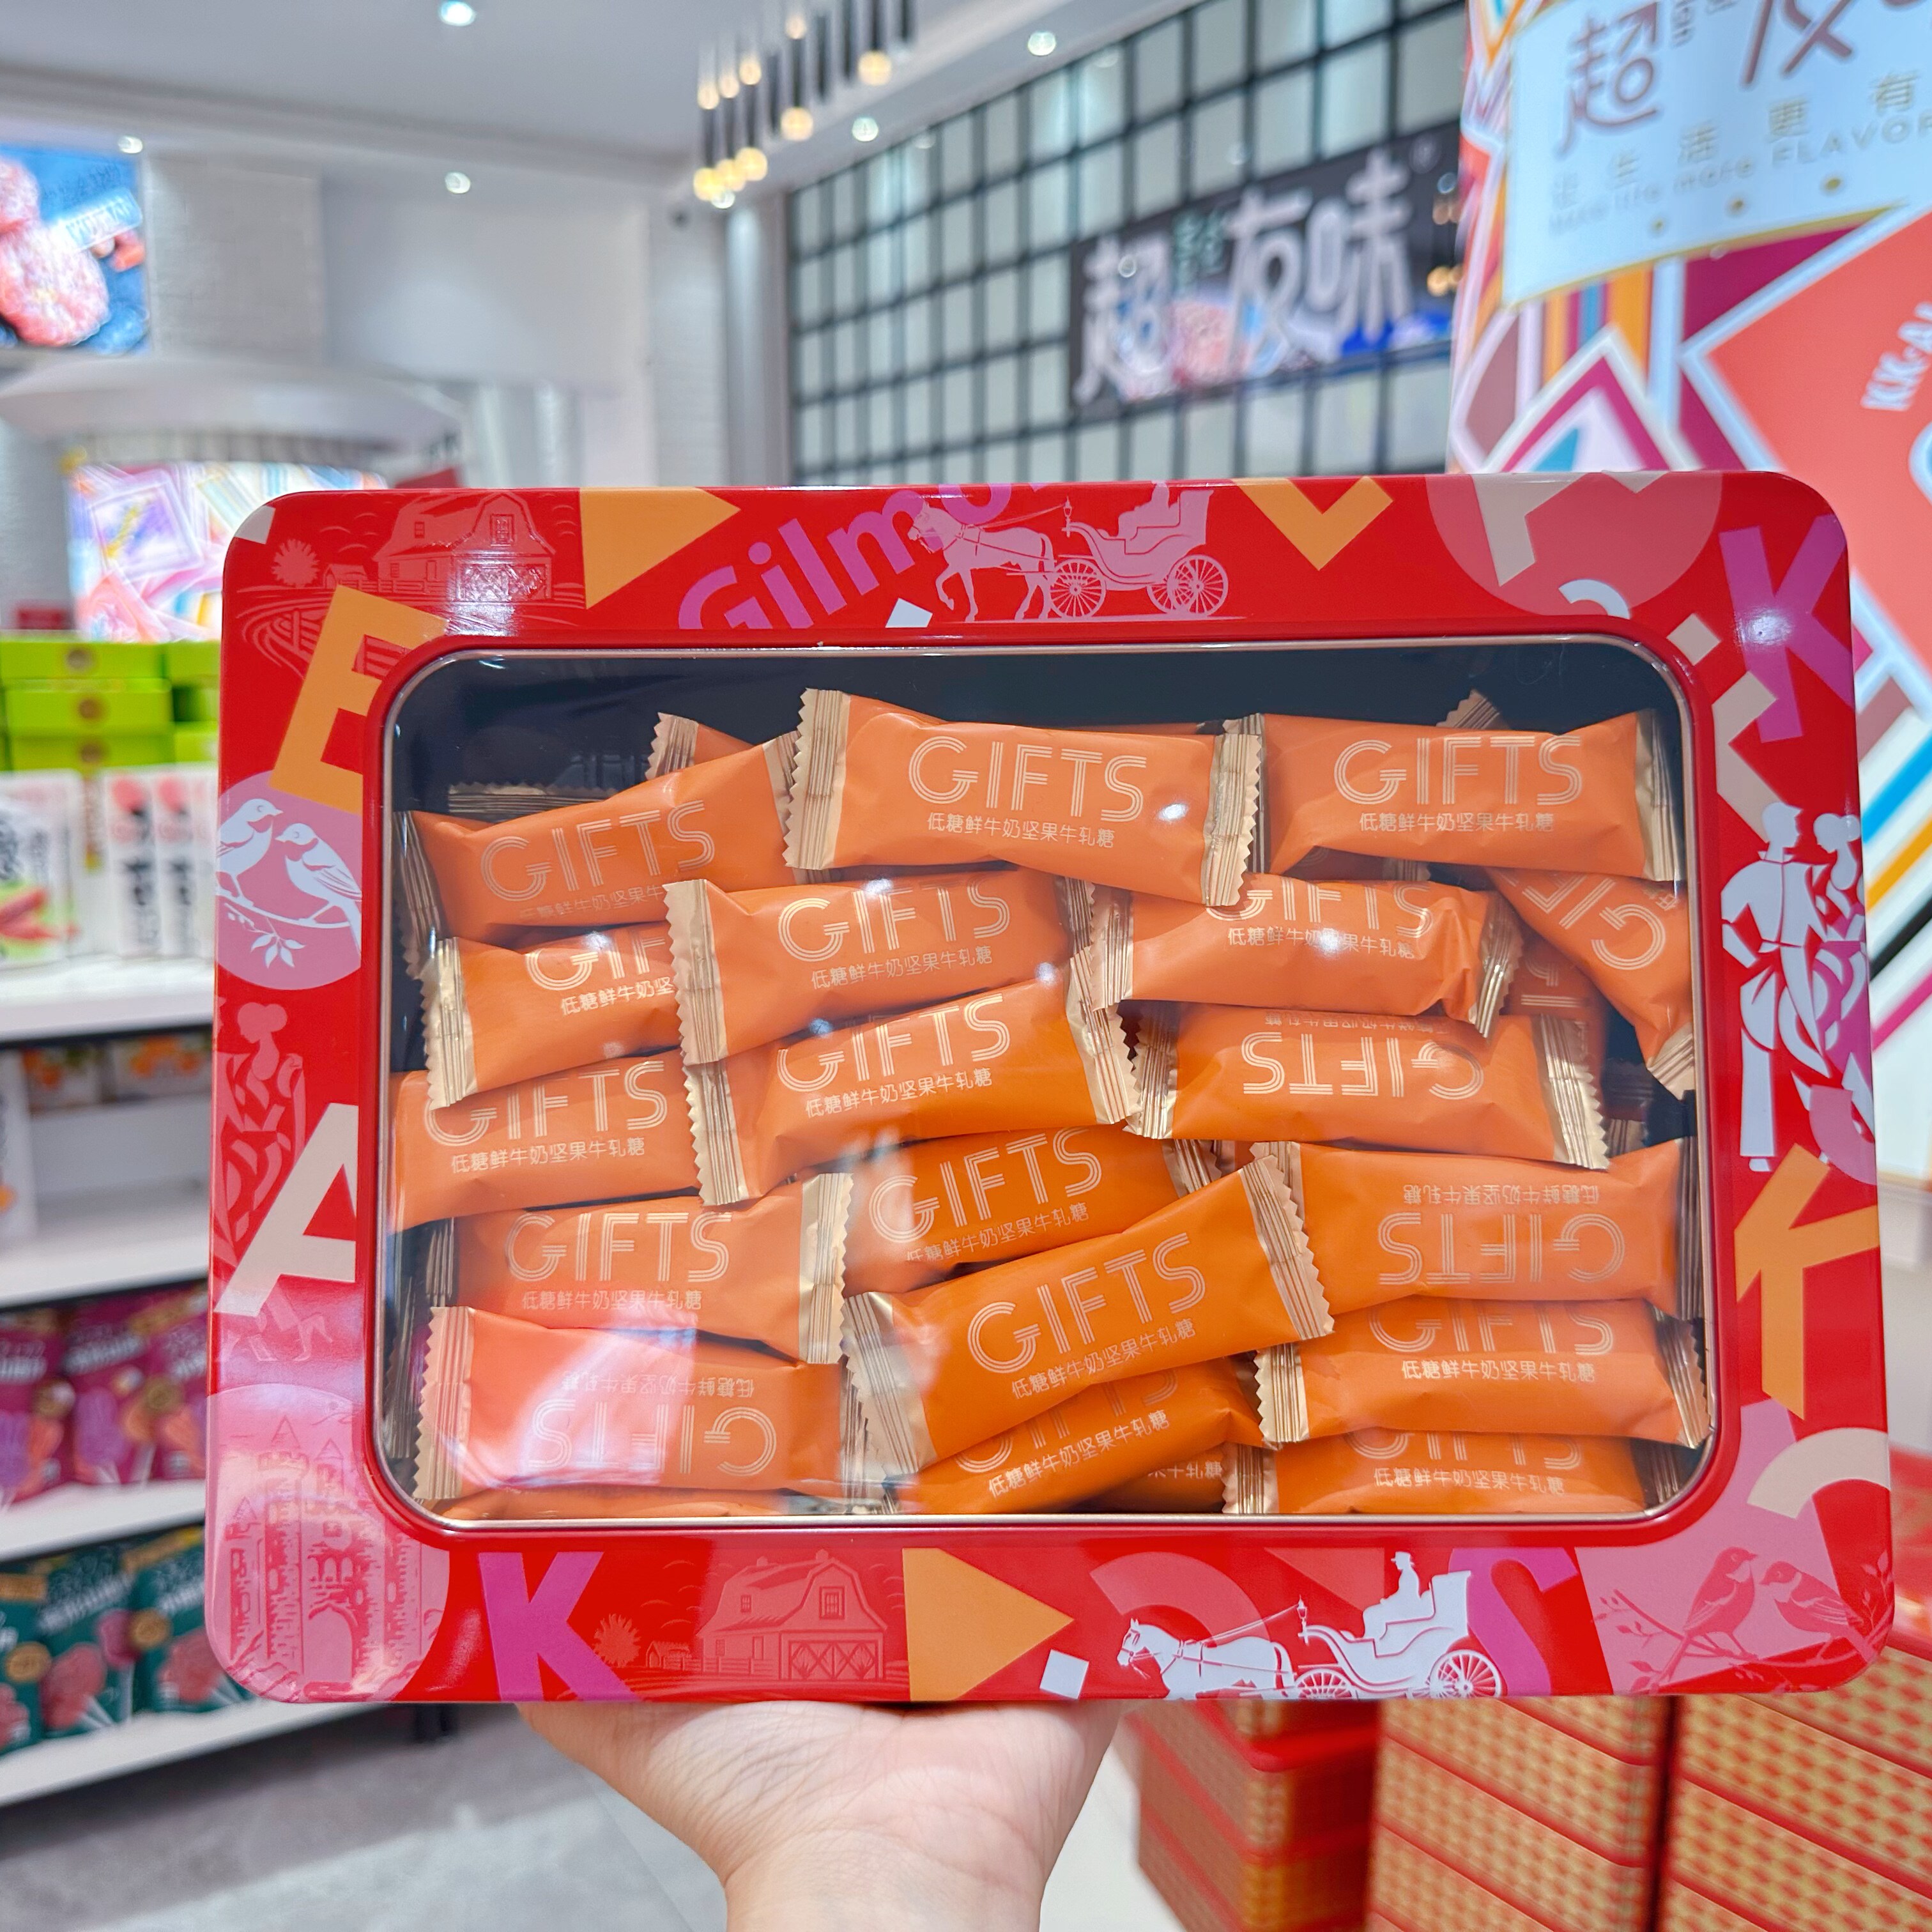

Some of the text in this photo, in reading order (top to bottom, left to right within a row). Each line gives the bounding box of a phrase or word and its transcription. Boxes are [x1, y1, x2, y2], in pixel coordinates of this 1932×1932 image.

[908, 735, 1147, 822] GIFTS
[1334, 735, 1583, 806] GIFTS
[481, 801, 716, 902] GIFTS
[927, 811, 1115, 848] 低糖鲜牛奶坚果牛轧糖
[1359, 812, 1554, 832] 低糖鲜牛奶坚果牛轧糖
[778, 879, 1011, 962] GIFTS
[560, 976, 675, 1016] 低糖鲜牛奶坚
[811, 945, 993, 990] 低糖鲜牛奶坚果牛轧糖
[776, 993, 1011, 1092] GIFTS
[1241, 1031, 1484, 1100] GIFTS
[424, 1060, 668, 1147] GIFTS
[806, 1067, 993, 1119] 低糖鲜牛奶坚果牛轧糖
[451, 1137, 645, 1174] 低糖鲜牛奶坚果牛轧糖
[869, 1126, 1103, 1243] GIFTS
[1403, 1184, 1599, 1206] 低糖鲜牛奶坚果牛轧糖
[504, 1211, 733, 1283] GIFTS
[1378, 1211, 1625, 1285] GIFTS
[521, 1288, 703, 1311] 低糖鲜牛奶坚果牛轧糖
[967, 1231, 1206, 1374] GIFTS
[1011, 1317, 1197, 1400] 低糖鲜牛奶坚果牛轧糖
[1401, 1359, 1595, 1383] 低糖鲜牛奶坚果牛轧糖
[528, 1399, 778, 1477] GIFTS
[988, 1409, 1170, 1498] 低糖鲜牛奶坚果牛轧糖
[1373, 1467, 1565, 1494] 低糖鲜牛奶坚果牛轧糖
